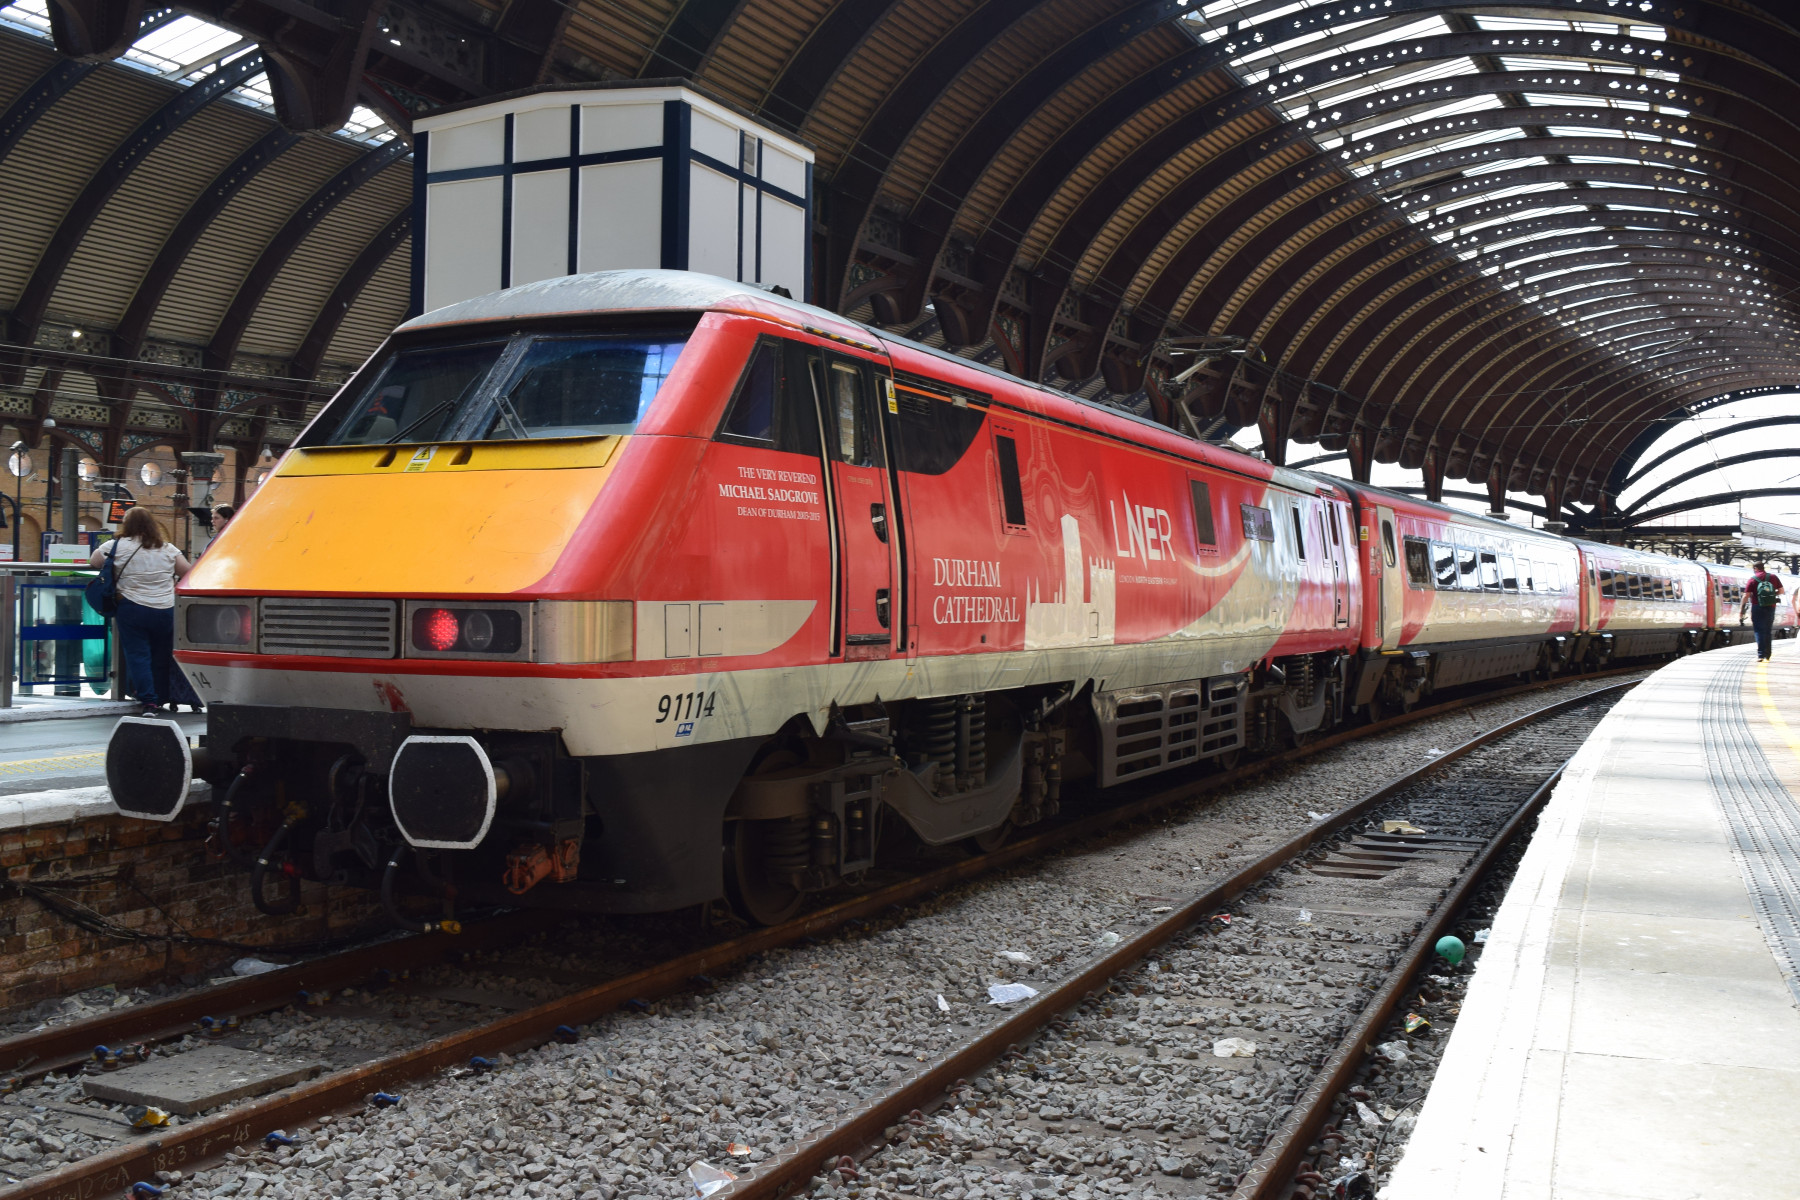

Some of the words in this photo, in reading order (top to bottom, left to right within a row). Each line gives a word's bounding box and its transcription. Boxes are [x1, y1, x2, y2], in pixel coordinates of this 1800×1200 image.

[738, 466, 755, 479] THE
[756, 468, 776, 480] VERY
[778, 470, 816, 485] REVEREND
[718, 483, 767, 500] MICHAEL
[768, 488, 819, 504] SADGROVE
[737, 506, 758, 517] DEAN
[758, 507, 767, 518] OF
[768, 508, 797, 520] DURHAM
[1110, 489, 1176, 571] LNER
[933, 558, 1002, 588] DURHAM
[933, 596, 1020, 625] CATHEDRAL
[191, 671, 212, 688] 14
[656, 691, 716, 723] 91114
